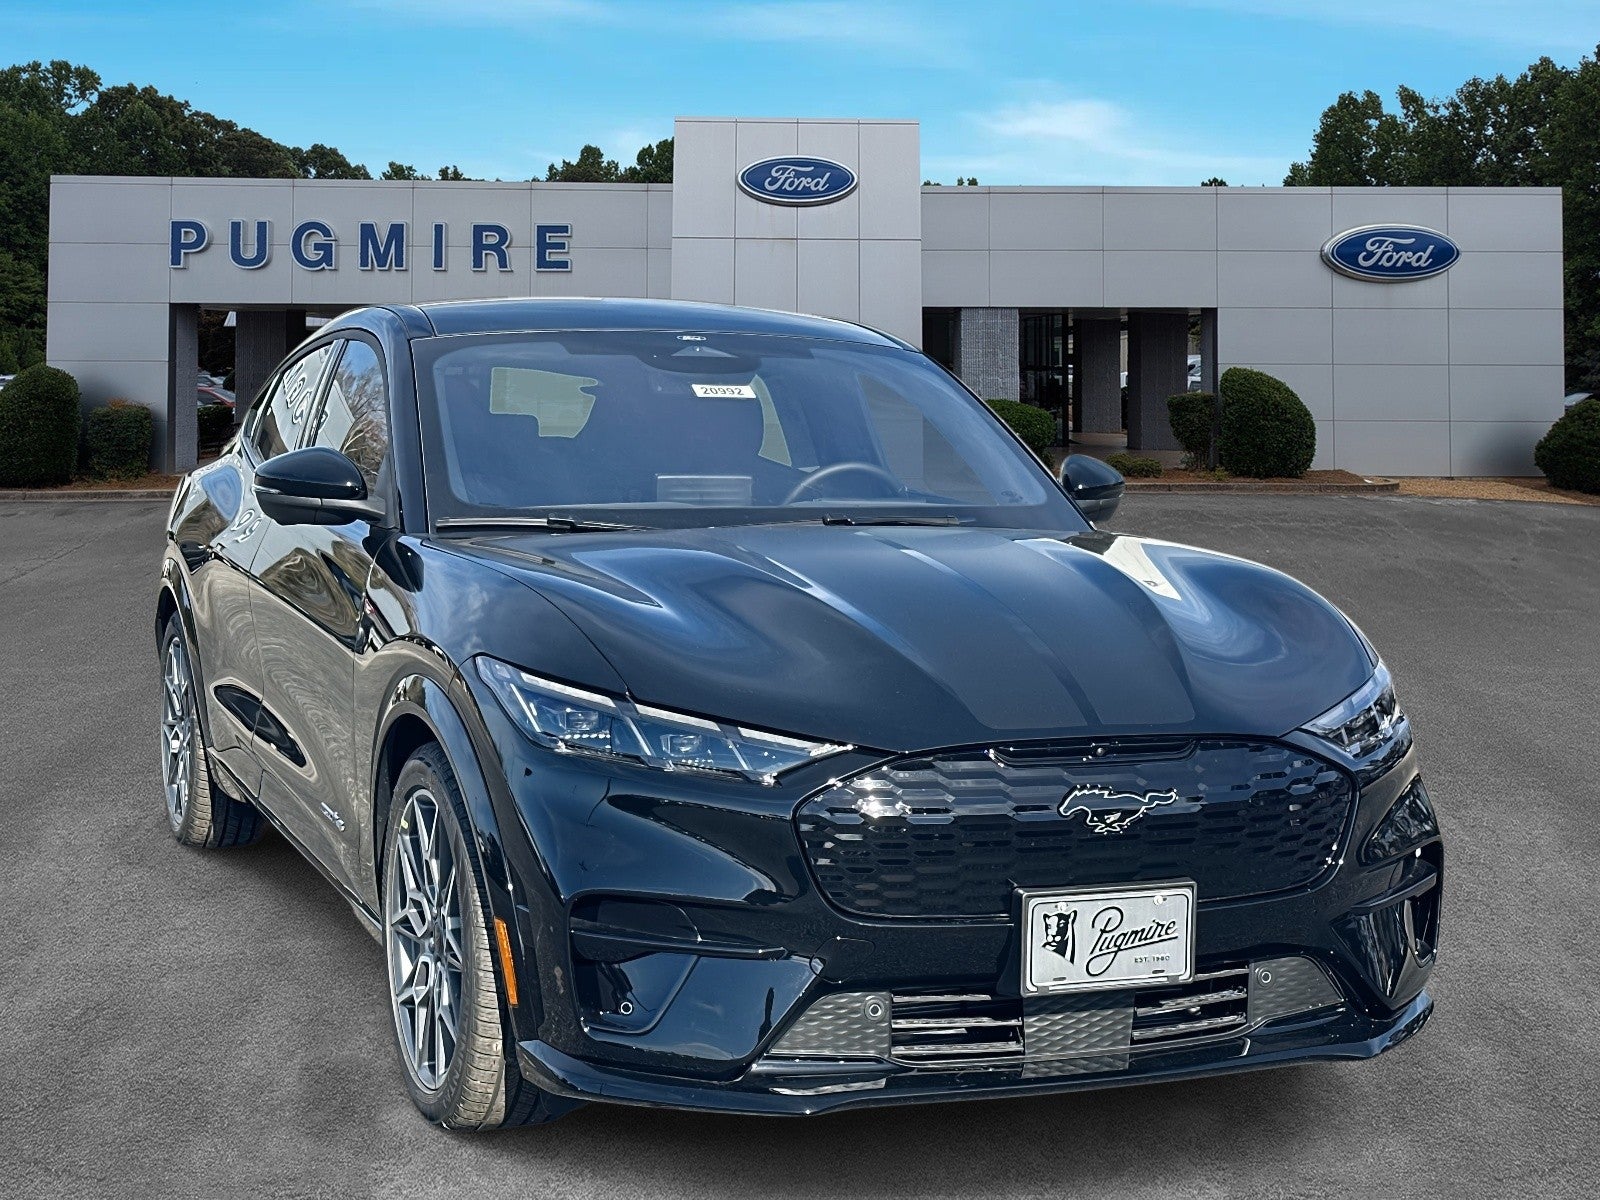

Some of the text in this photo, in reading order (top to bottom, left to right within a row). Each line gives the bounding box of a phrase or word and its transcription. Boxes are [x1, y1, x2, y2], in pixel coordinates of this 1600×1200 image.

[763, 164, 831, 191] Ford
[168, 218, 574, 273] PUGMIRE
[1357, 236, 1435, 268] Ford
[700, 386, 744, 396] 20992
[1085, 905, 1178, 977] Pugmire
